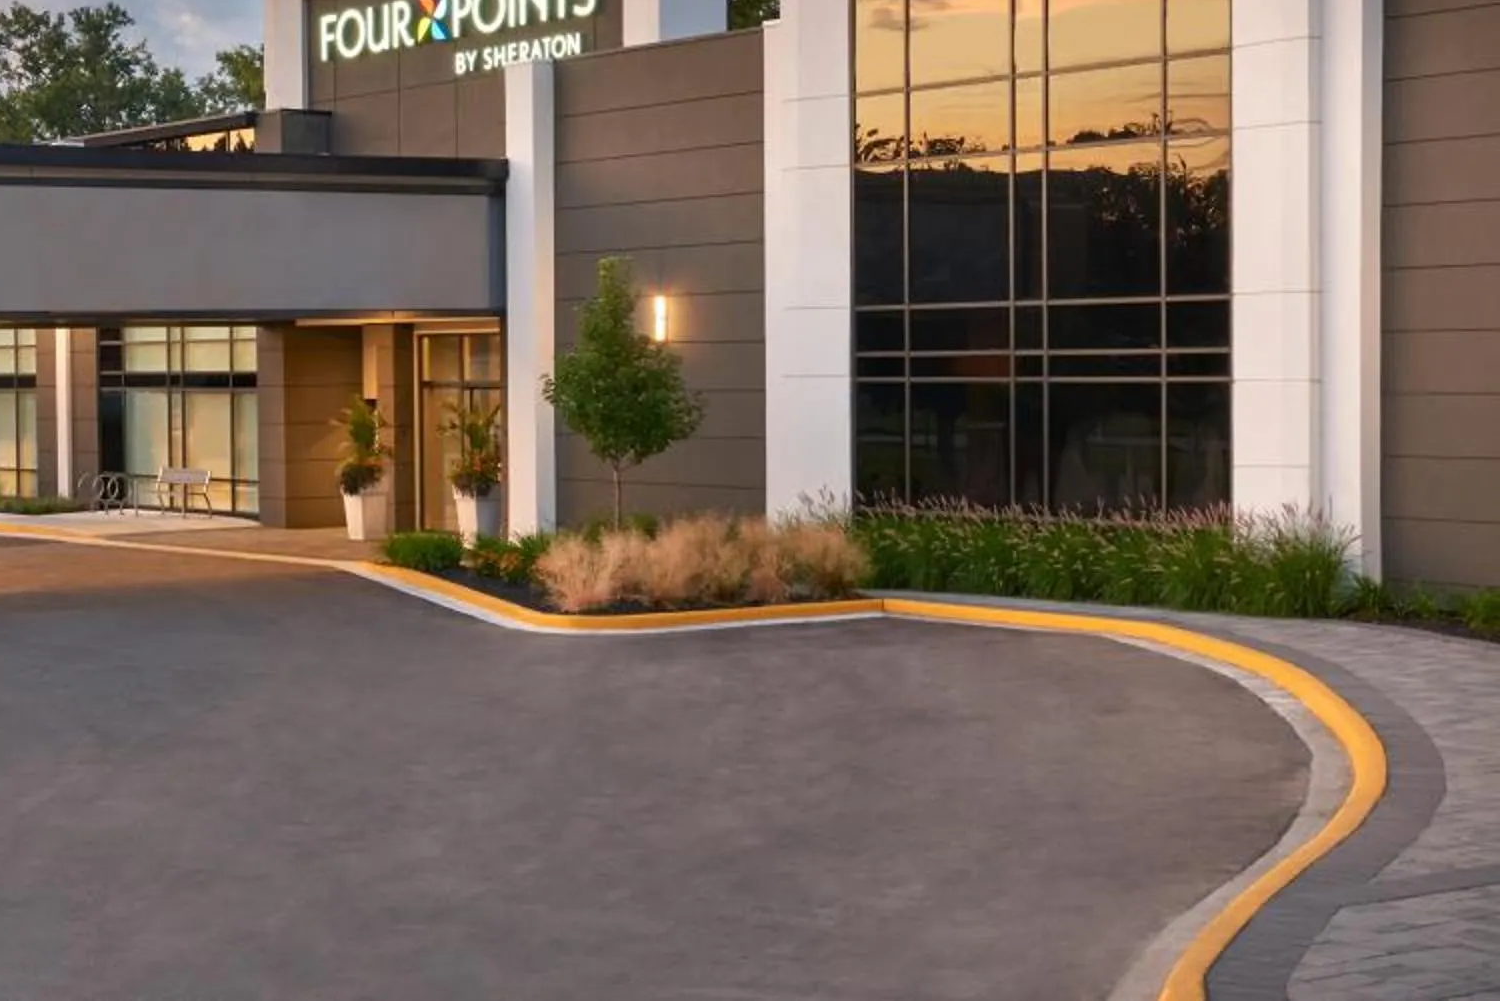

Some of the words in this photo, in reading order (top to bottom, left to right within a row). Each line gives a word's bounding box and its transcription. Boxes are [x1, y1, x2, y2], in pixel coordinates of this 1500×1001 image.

[320, 0, 414, 61] FOUR
[455, 51, 477, 74] BY
[483, 32, 581, 70] SHERATON
